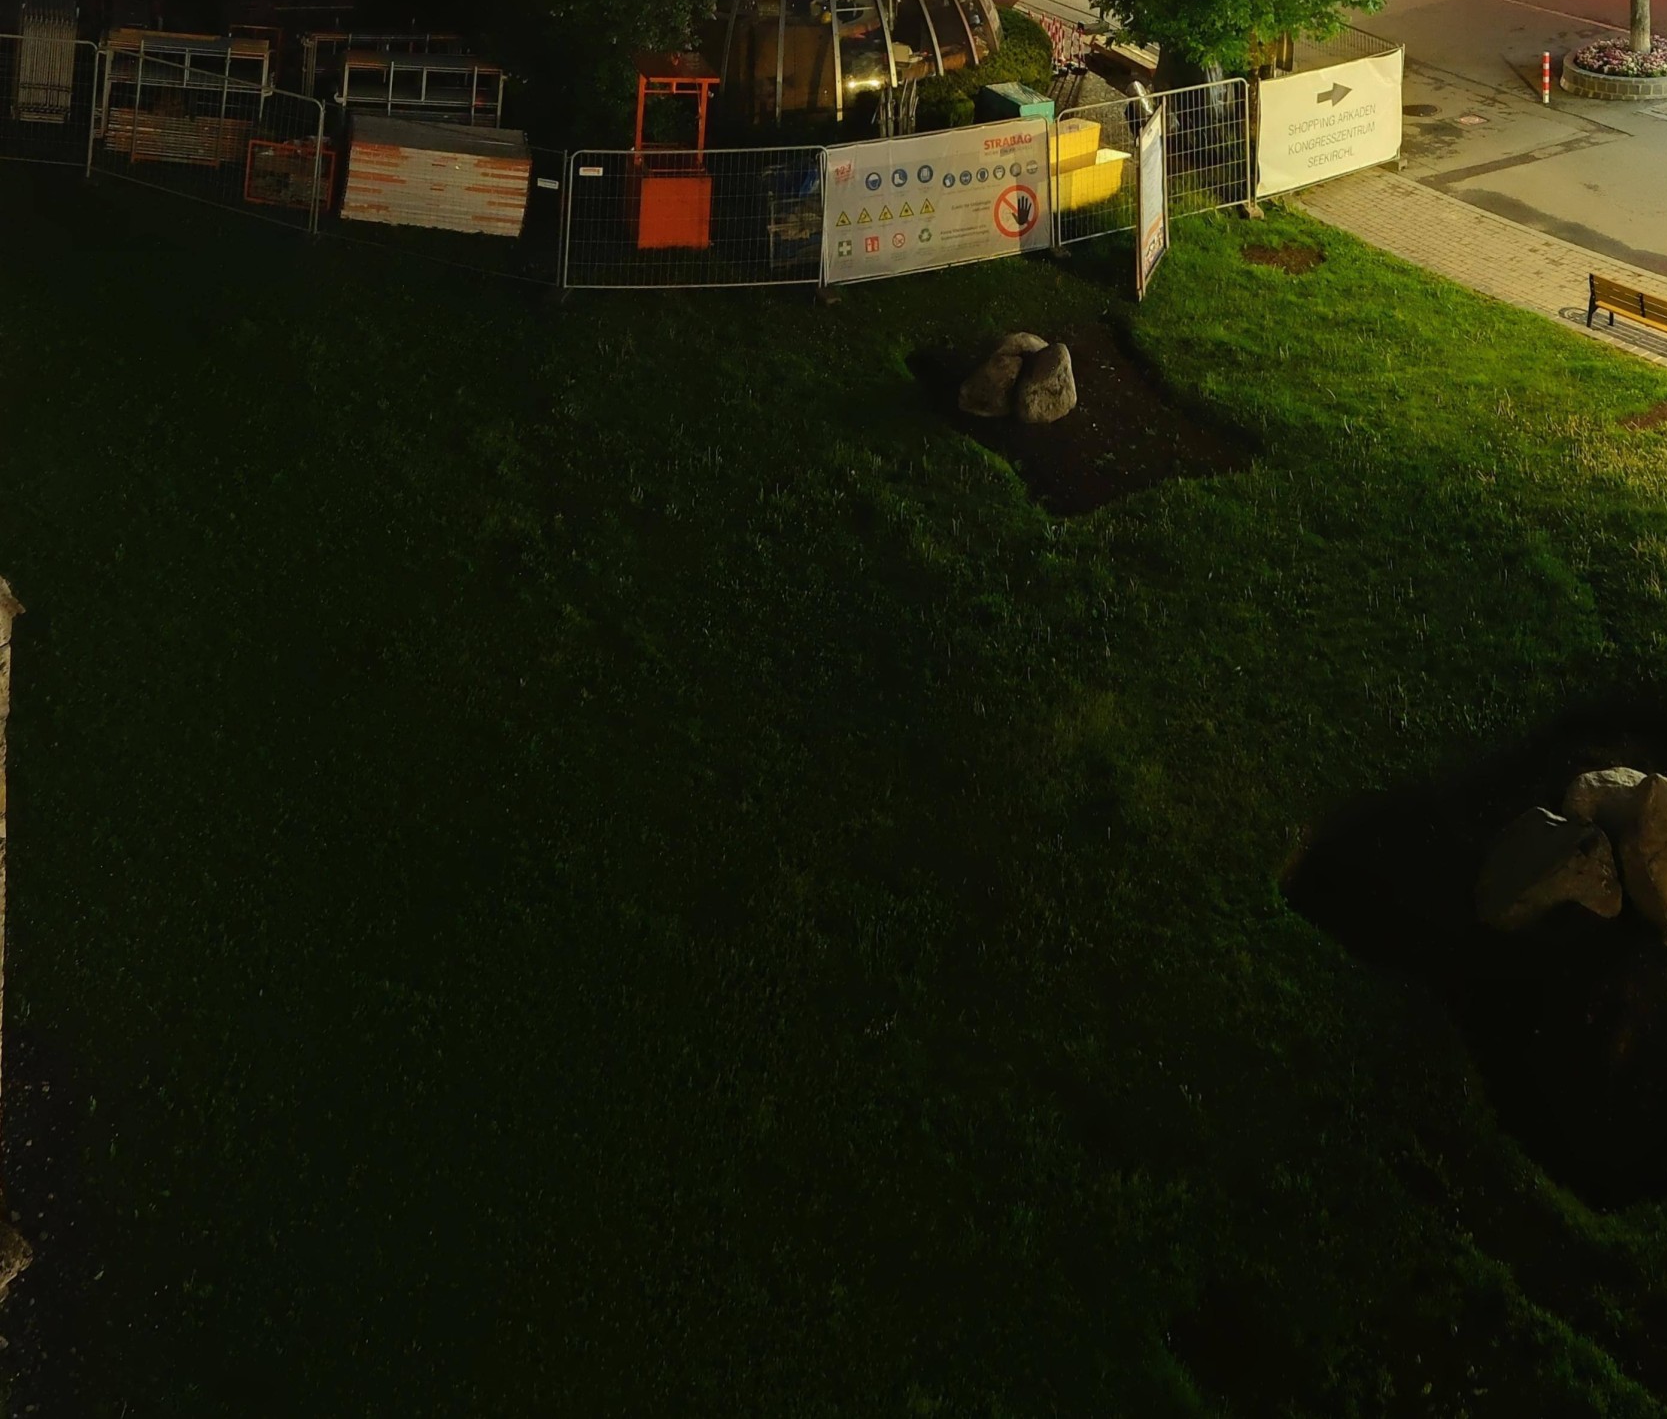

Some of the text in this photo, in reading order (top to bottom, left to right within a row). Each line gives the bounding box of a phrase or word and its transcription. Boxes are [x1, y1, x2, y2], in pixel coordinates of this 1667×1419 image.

[1288, 103, 1376, 136] SHOPPING ARKADEN
[984, 133, 1032, 150] STRABAG
[1288, 121, 1376, 155] KONGRESSZENTRUM
[1307, 146, 1355, 168] SEEKIRCHL
